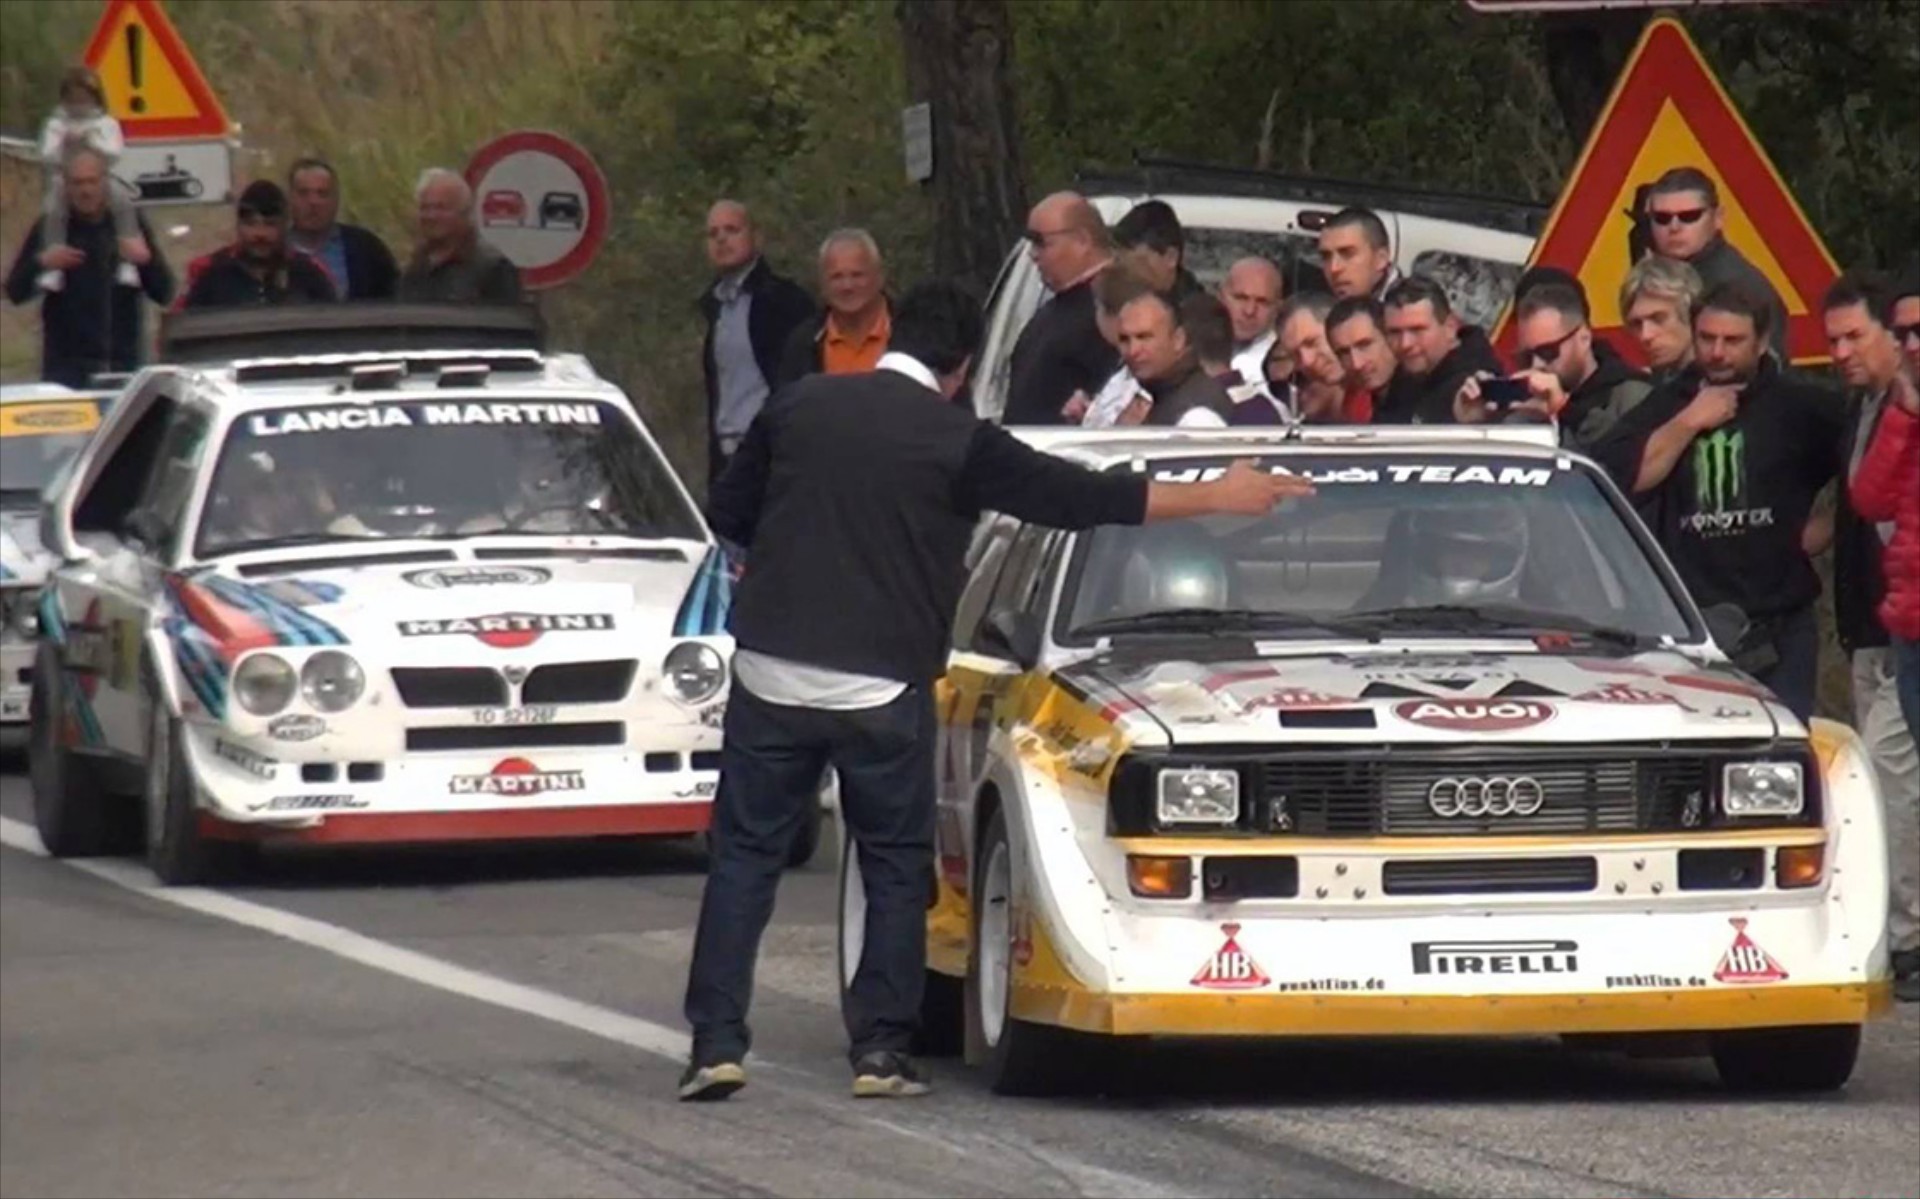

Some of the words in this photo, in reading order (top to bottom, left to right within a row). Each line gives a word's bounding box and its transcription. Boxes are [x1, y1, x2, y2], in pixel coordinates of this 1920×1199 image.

[250, 405, 412, 435] LANCIA
[422, 404, 600, 425] MARTINI
[1386, 465, 1550, 486] TEAM
[407, 613, 607, 634] MARTINI
[452, 772, 583, 793] MARTINI
[1209, 951, 1252, 979] HB
[1411, 940, 1578, 974] PIRELLI
[1726, 945, 1768, 973] HB
